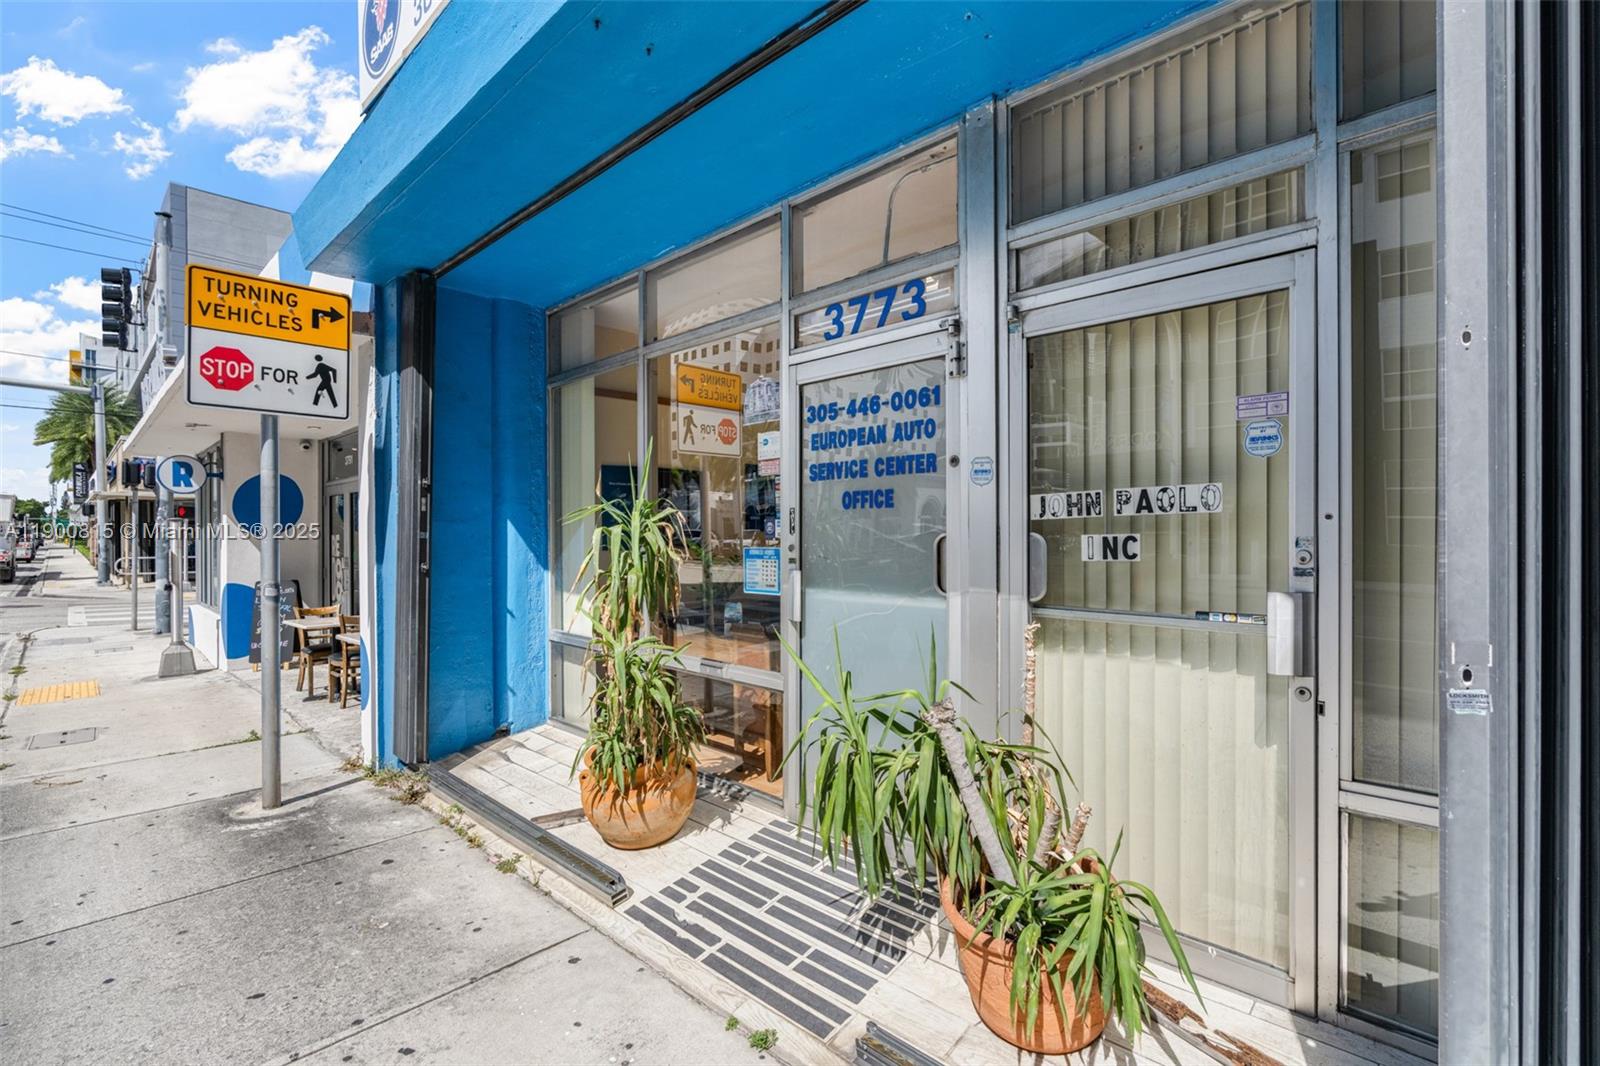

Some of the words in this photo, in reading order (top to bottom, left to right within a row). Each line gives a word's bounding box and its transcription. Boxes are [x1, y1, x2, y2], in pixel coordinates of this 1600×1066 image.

[370, 22, 394, 65] SAAB
[203, 276, 299, 308] TURNING
[197, 300, 303, 332] VEHICLES
[823, 278, 927, 341] 3773
[201, 357, 253, 380] STOP
[261, 366, 299, 385] FOR
[806, 385, 941, 424] 305-446-0061
[811, 424, 886, 451] EUROPEAN
[892, 418, 937, 443] AUTO
[171, 460, 194, 487] R
[809, 458, 868, 482] SERVICE
[874, 452, 937, 477] CENTER
[841, 488, 894, 511] OFFICE
[1039, 491, 1102, 519] JOHN
[1116, 484, 1222, 515] PAOLO
[1087, 535, 1138, 560] INC
